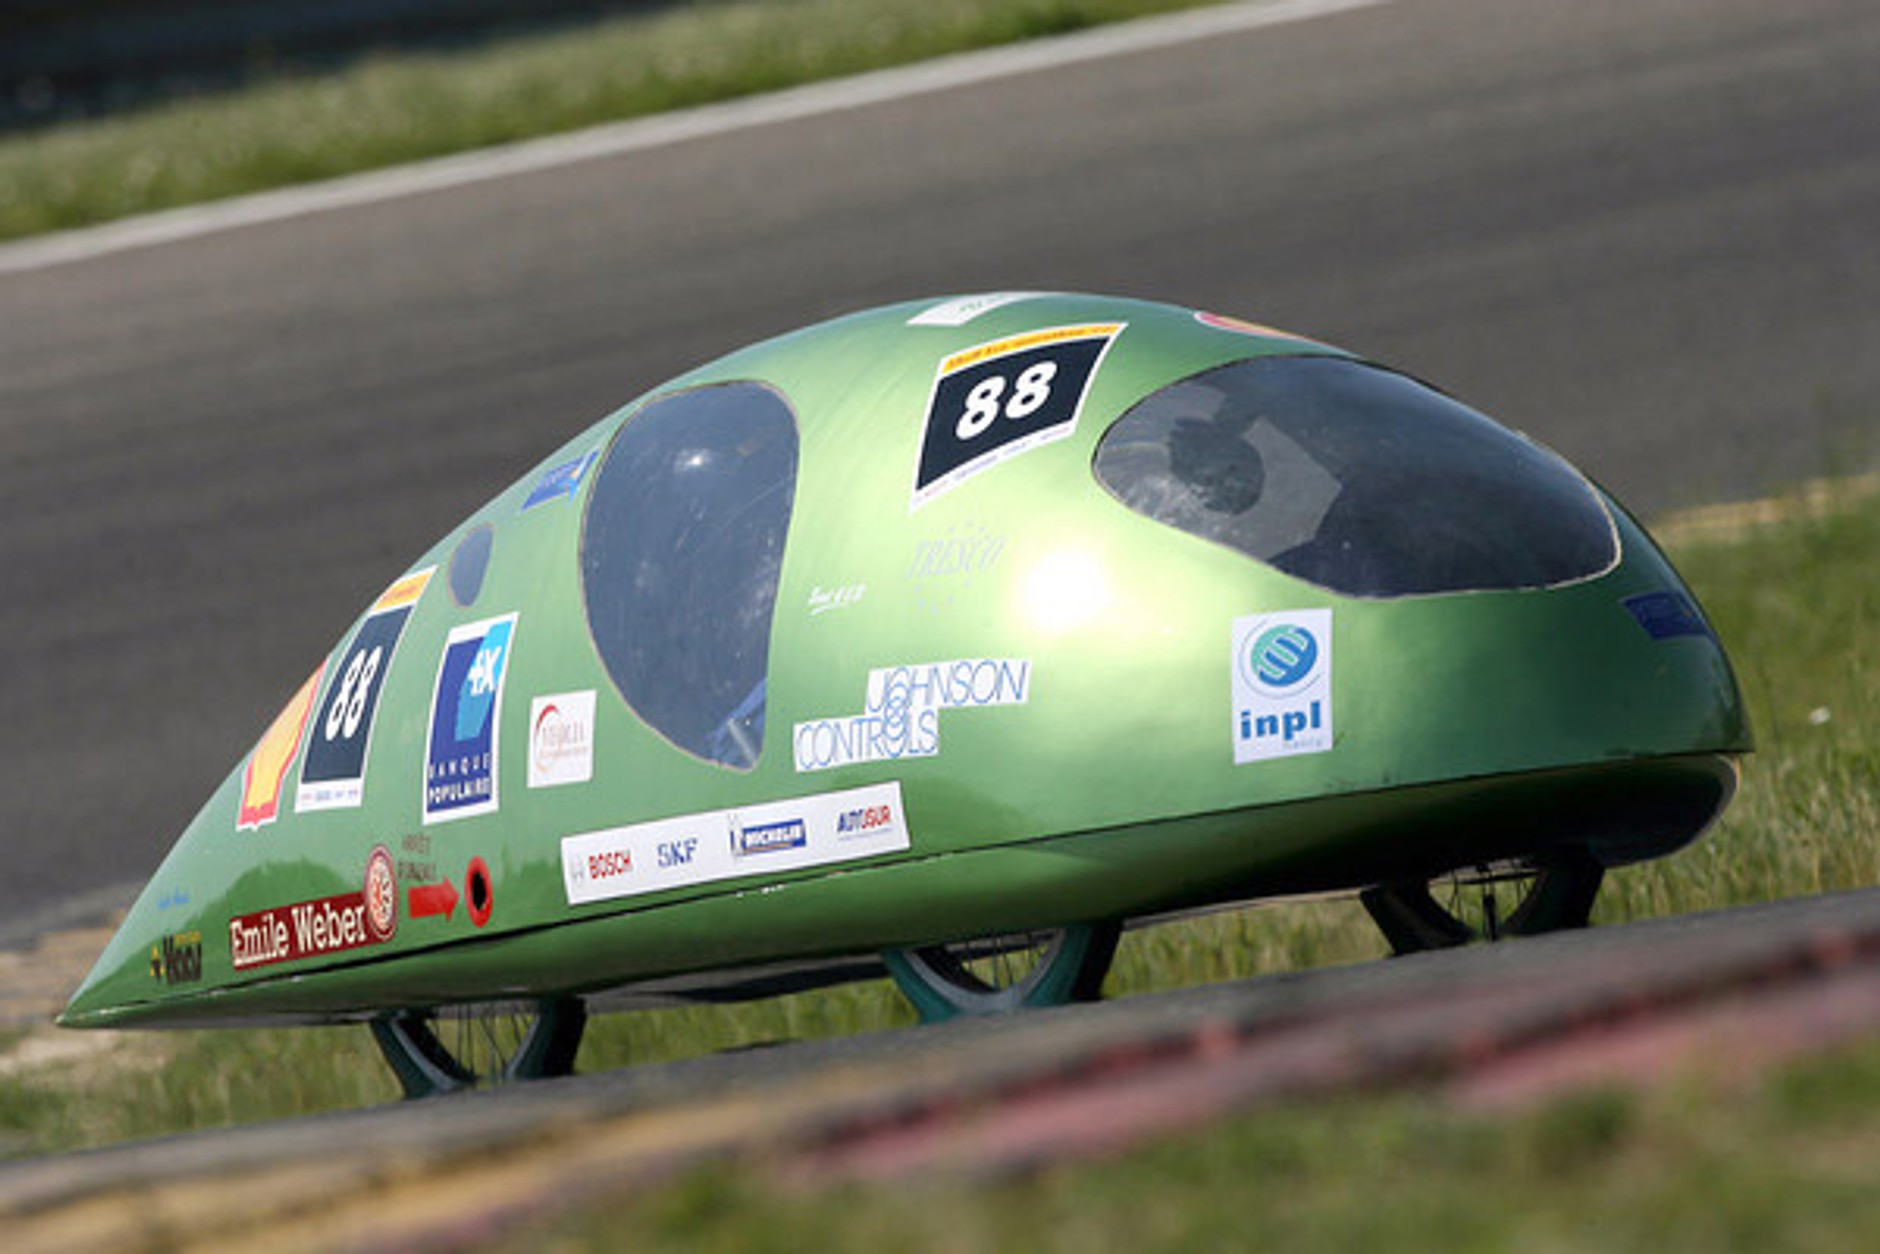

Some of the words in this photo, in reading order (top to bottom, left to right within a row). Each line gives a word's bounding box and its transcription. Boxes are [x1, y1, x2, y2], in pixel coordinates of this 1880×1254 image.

[956, 361, 1057, 440] 88
[325, 645, 383, 741] 88
[866, 660, 1028, 713] JOHNSON
[798, 708, 939, 769] CONTROLS
[1240, 701, 1321, 741] inpl
[428, 753, 491, 780] BANQUE
[428, 777, 491, 804] POPULAIRE
[588, 850, 632, 880] BOSCH
[656, 837, 699, 868] SKF
[231, 912, 290, 967] Emile
[291, 903, 367, 952] Weber
